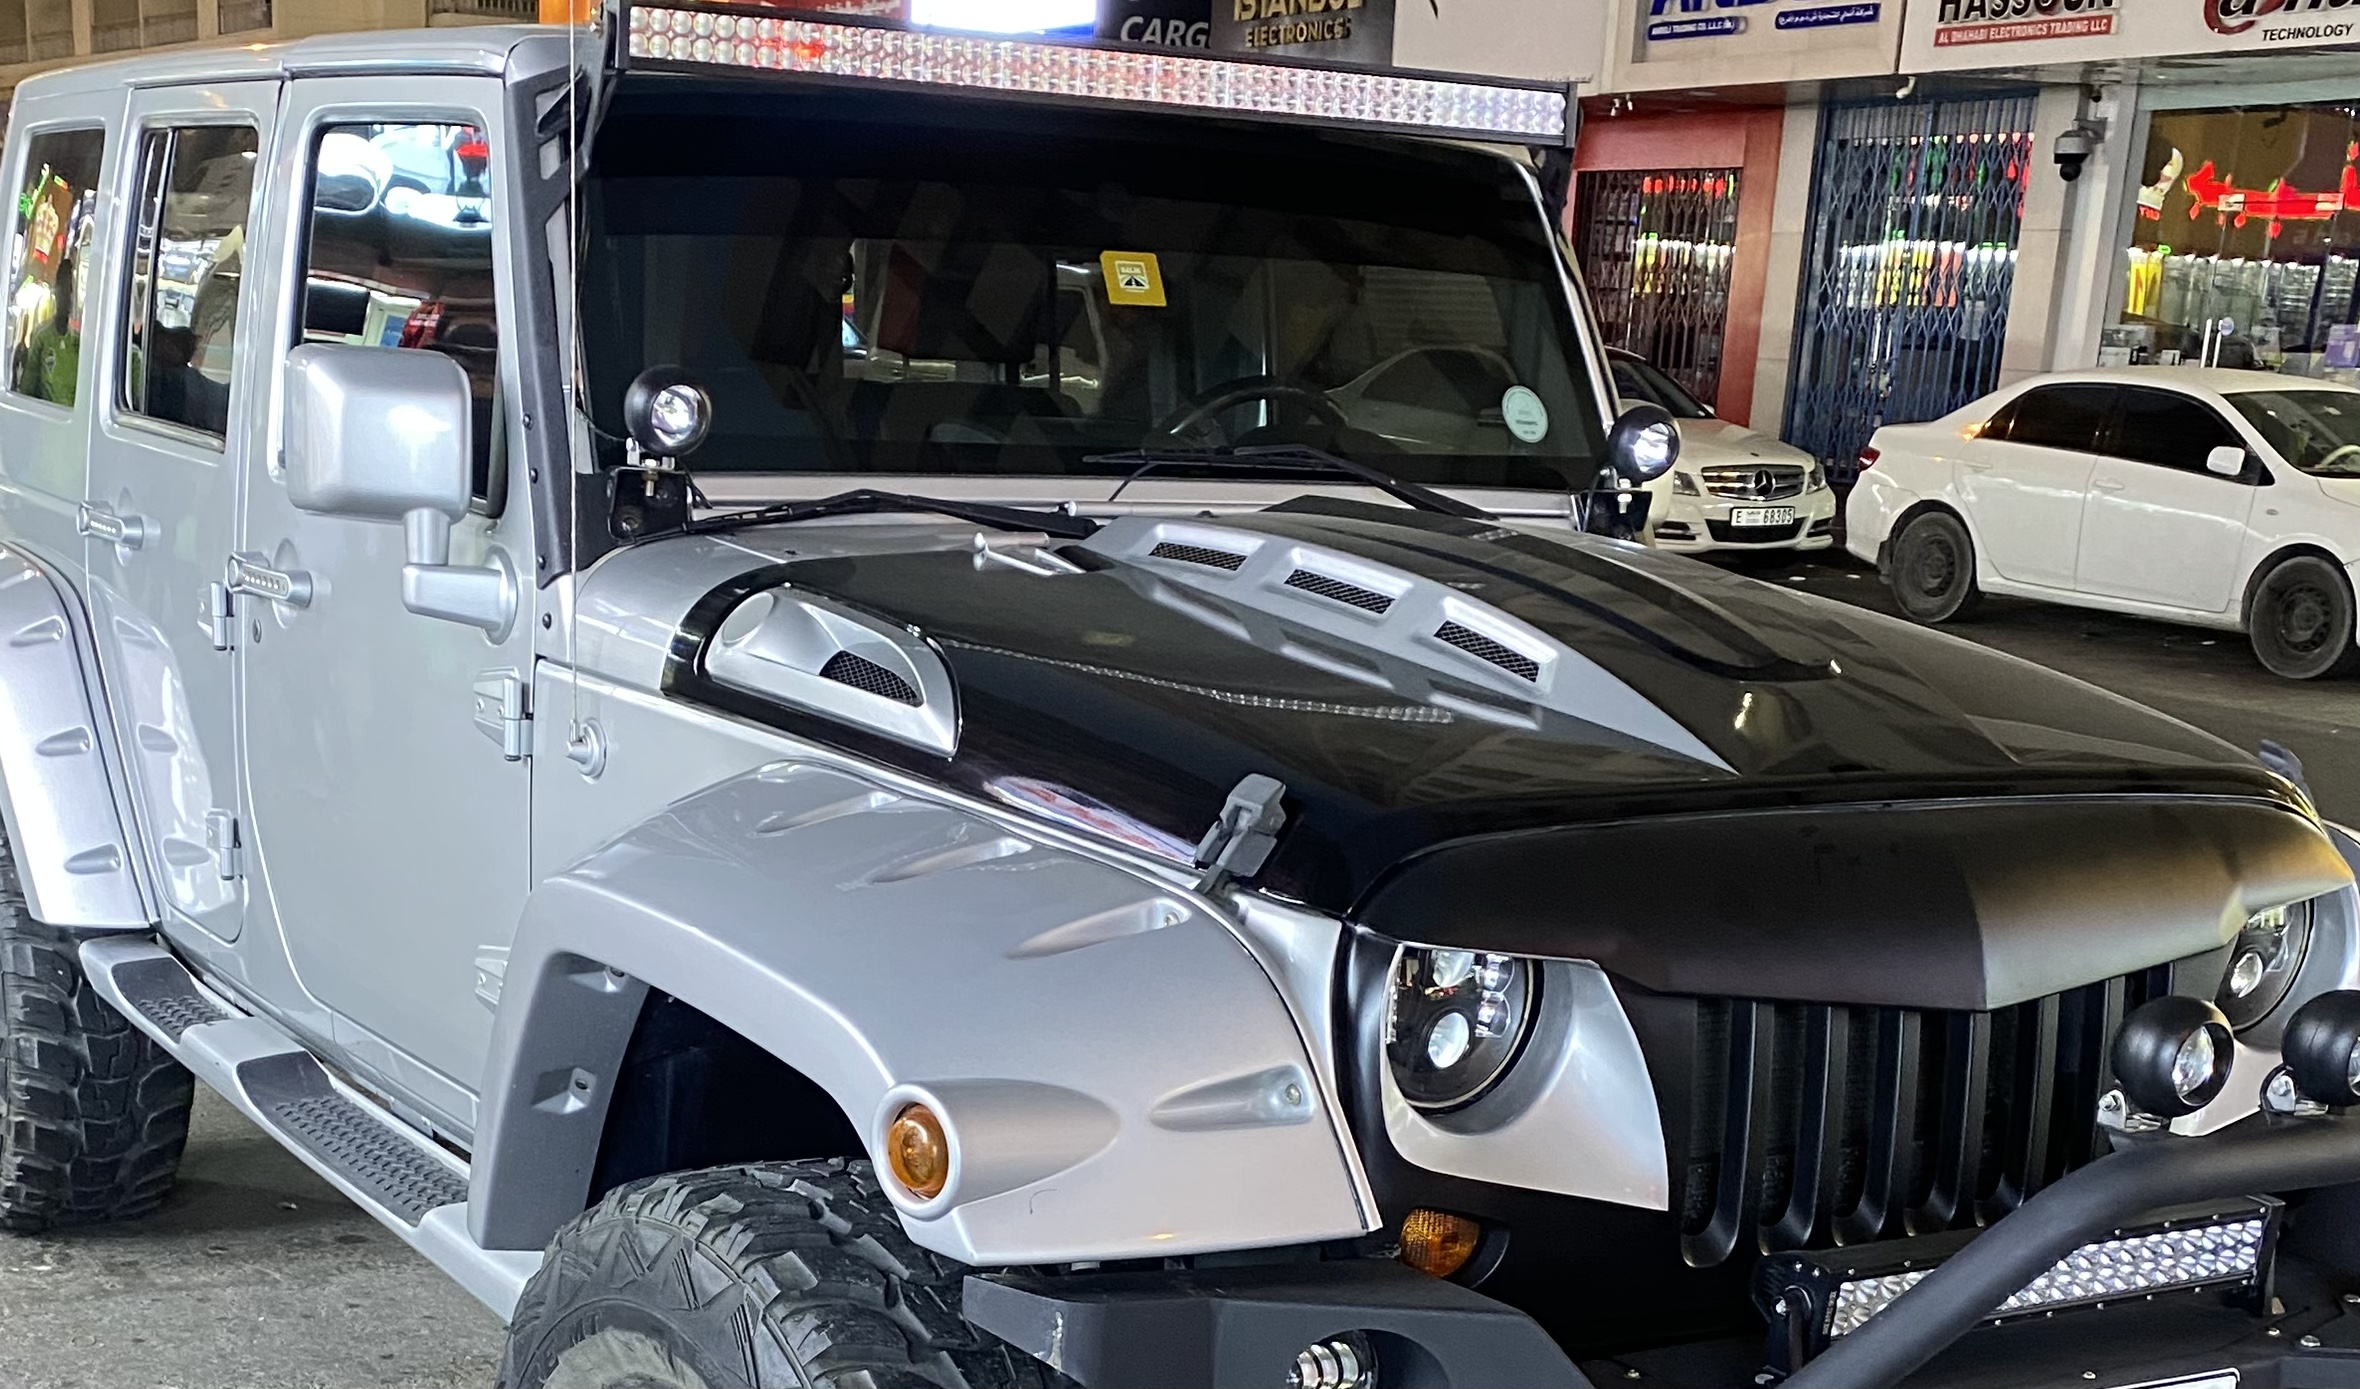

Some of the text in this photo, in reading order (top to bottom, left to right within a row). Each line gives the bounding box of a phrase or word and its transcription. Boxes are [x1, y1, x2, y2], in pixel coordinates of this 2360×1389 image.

[1120, 16, 1211, 48] CARG
[1244, 18, 1347, 48] ELECTRONICS
[1938, 32, 1949, 43] AL
[1989, 23, 2047, 39] ELECTRONICS
[2050, 20, 2089, 34] TRADING
[2090, 19, 2108, 31] LLC
[2262, 24, 2354, 41] TECHNOLOGY
[1736, 510, 1743, 523] E
